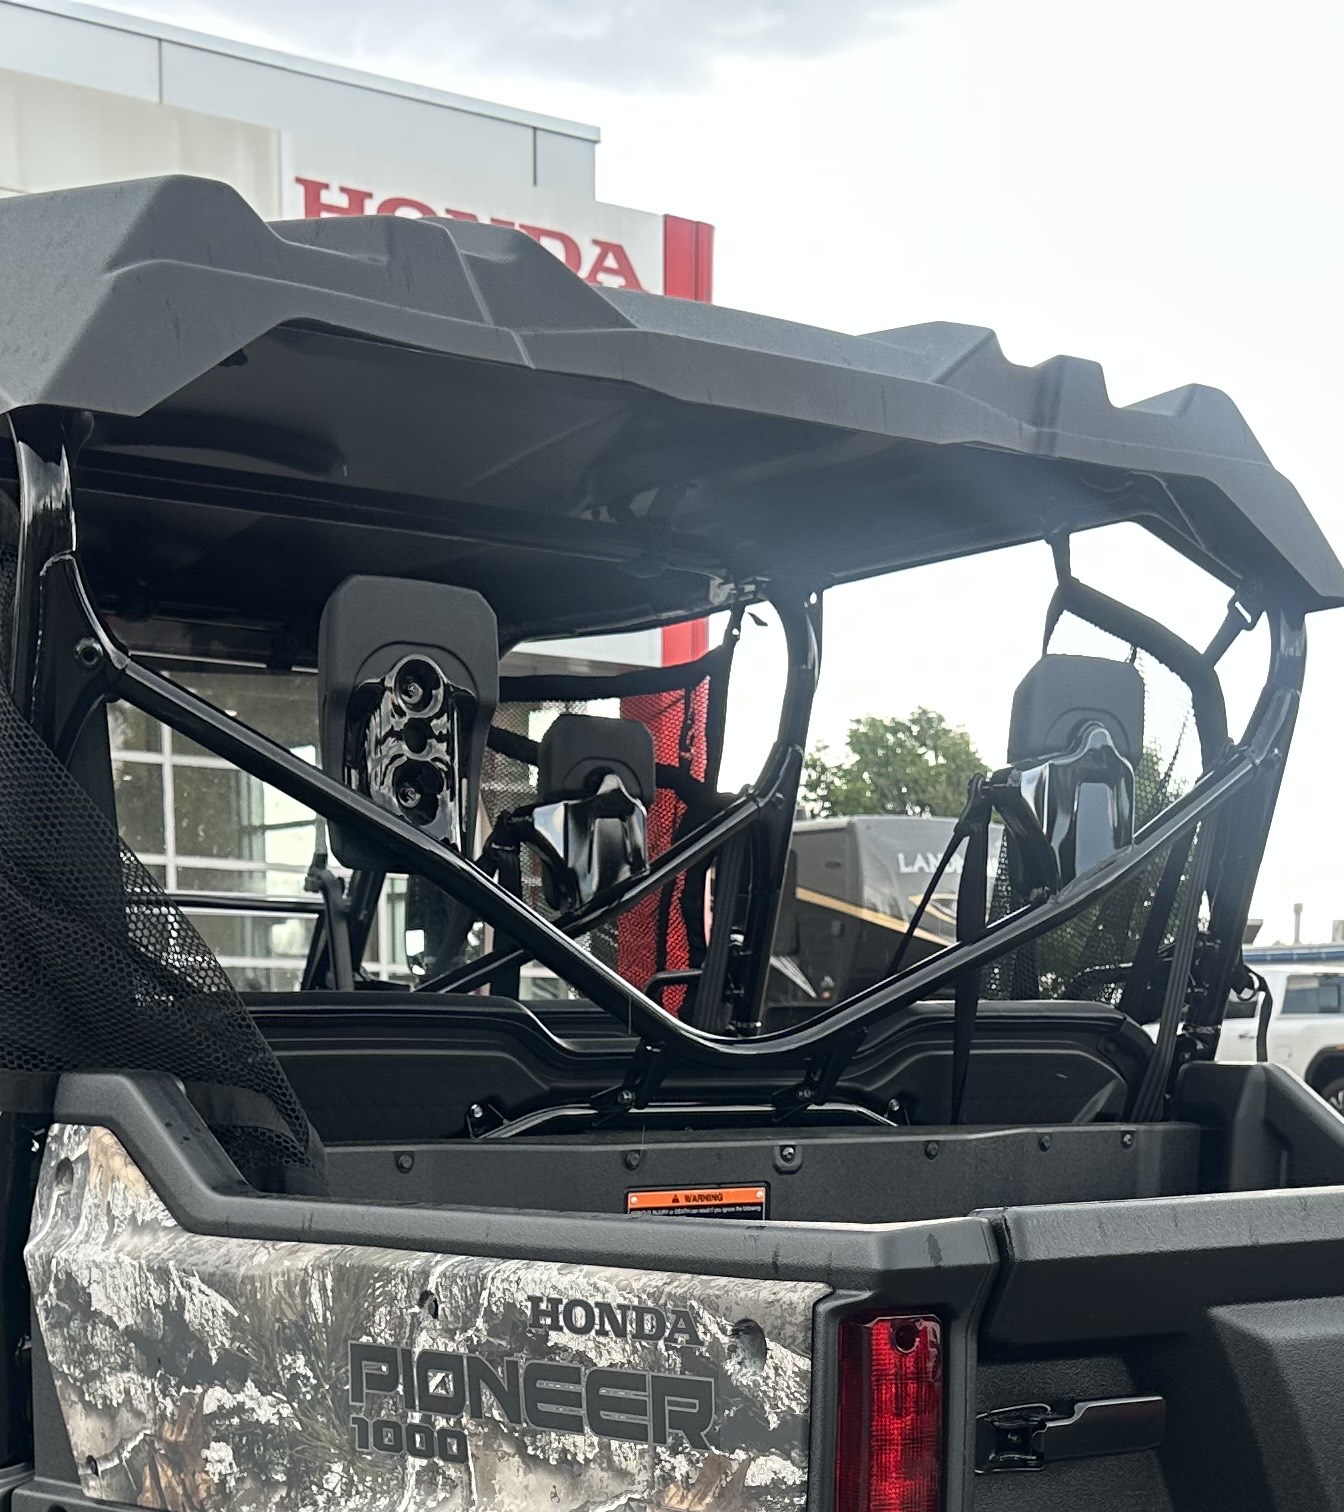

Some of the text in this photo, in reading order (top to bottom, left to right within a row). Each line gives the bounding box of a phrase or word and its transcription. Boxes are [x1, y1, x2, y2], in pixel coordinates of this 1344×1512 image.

[295, 176, 649, 292] HDA
[684, 1192, 724, 1203] WARNING
[527, 1295, 705, 1347] HONDA
[348, 1341, 717, 1451] PIONEER
[351, 1415, 470, 1464] 1000
